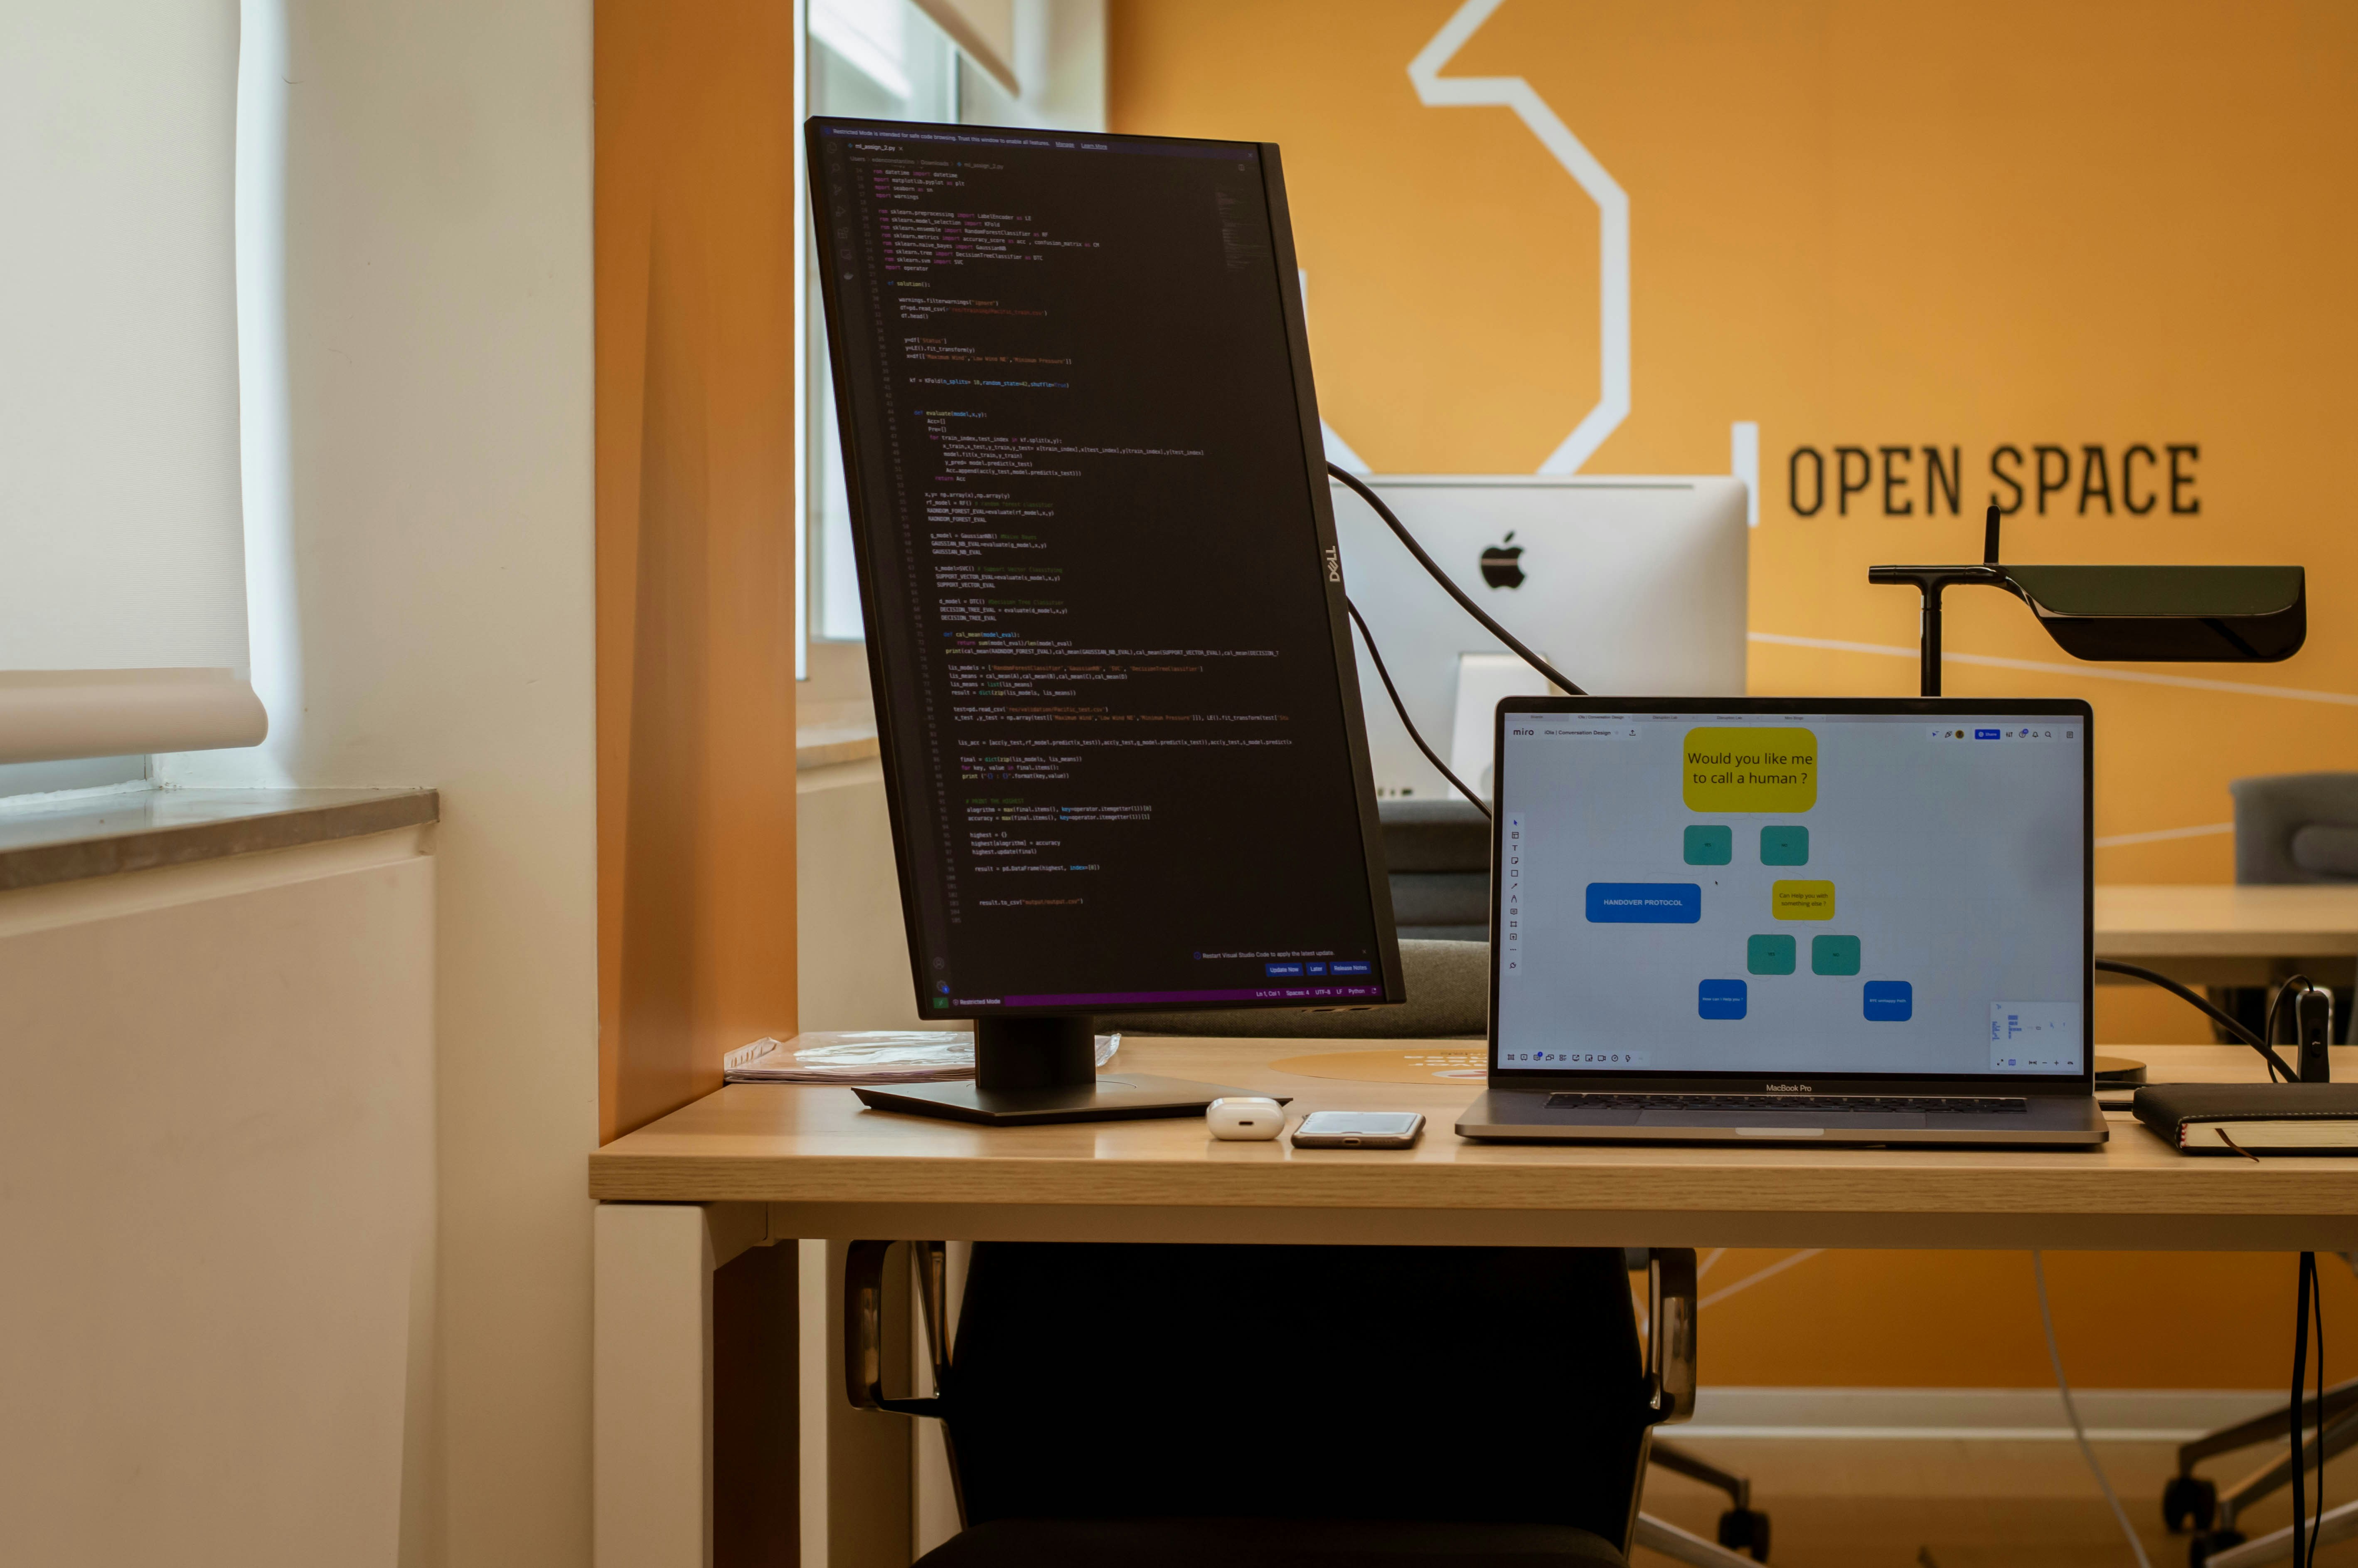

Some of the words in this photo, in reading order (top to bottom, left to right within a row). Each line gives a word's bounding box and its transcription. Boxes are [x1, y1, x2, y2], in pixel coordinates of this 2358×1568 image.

[1789, 445, 1960, 517] OPEN
[1990, 443, 2201, 516] SPACE
[1325, 545, 1341, 582] DELL
[1688, 752, 1731, 765] Would
[1735, 755, 1760, 768] you
[1765, 752, 1787, 765] like
[1792, 755, 1813, 765] me
[1693, 773, 1707, 784] to
[1711, 771, 1733, 784] call
[1737, 774, 1745, 784] a
[1749, 771, 1797, 784] human
[1801, 772, 1807, 784] ?
